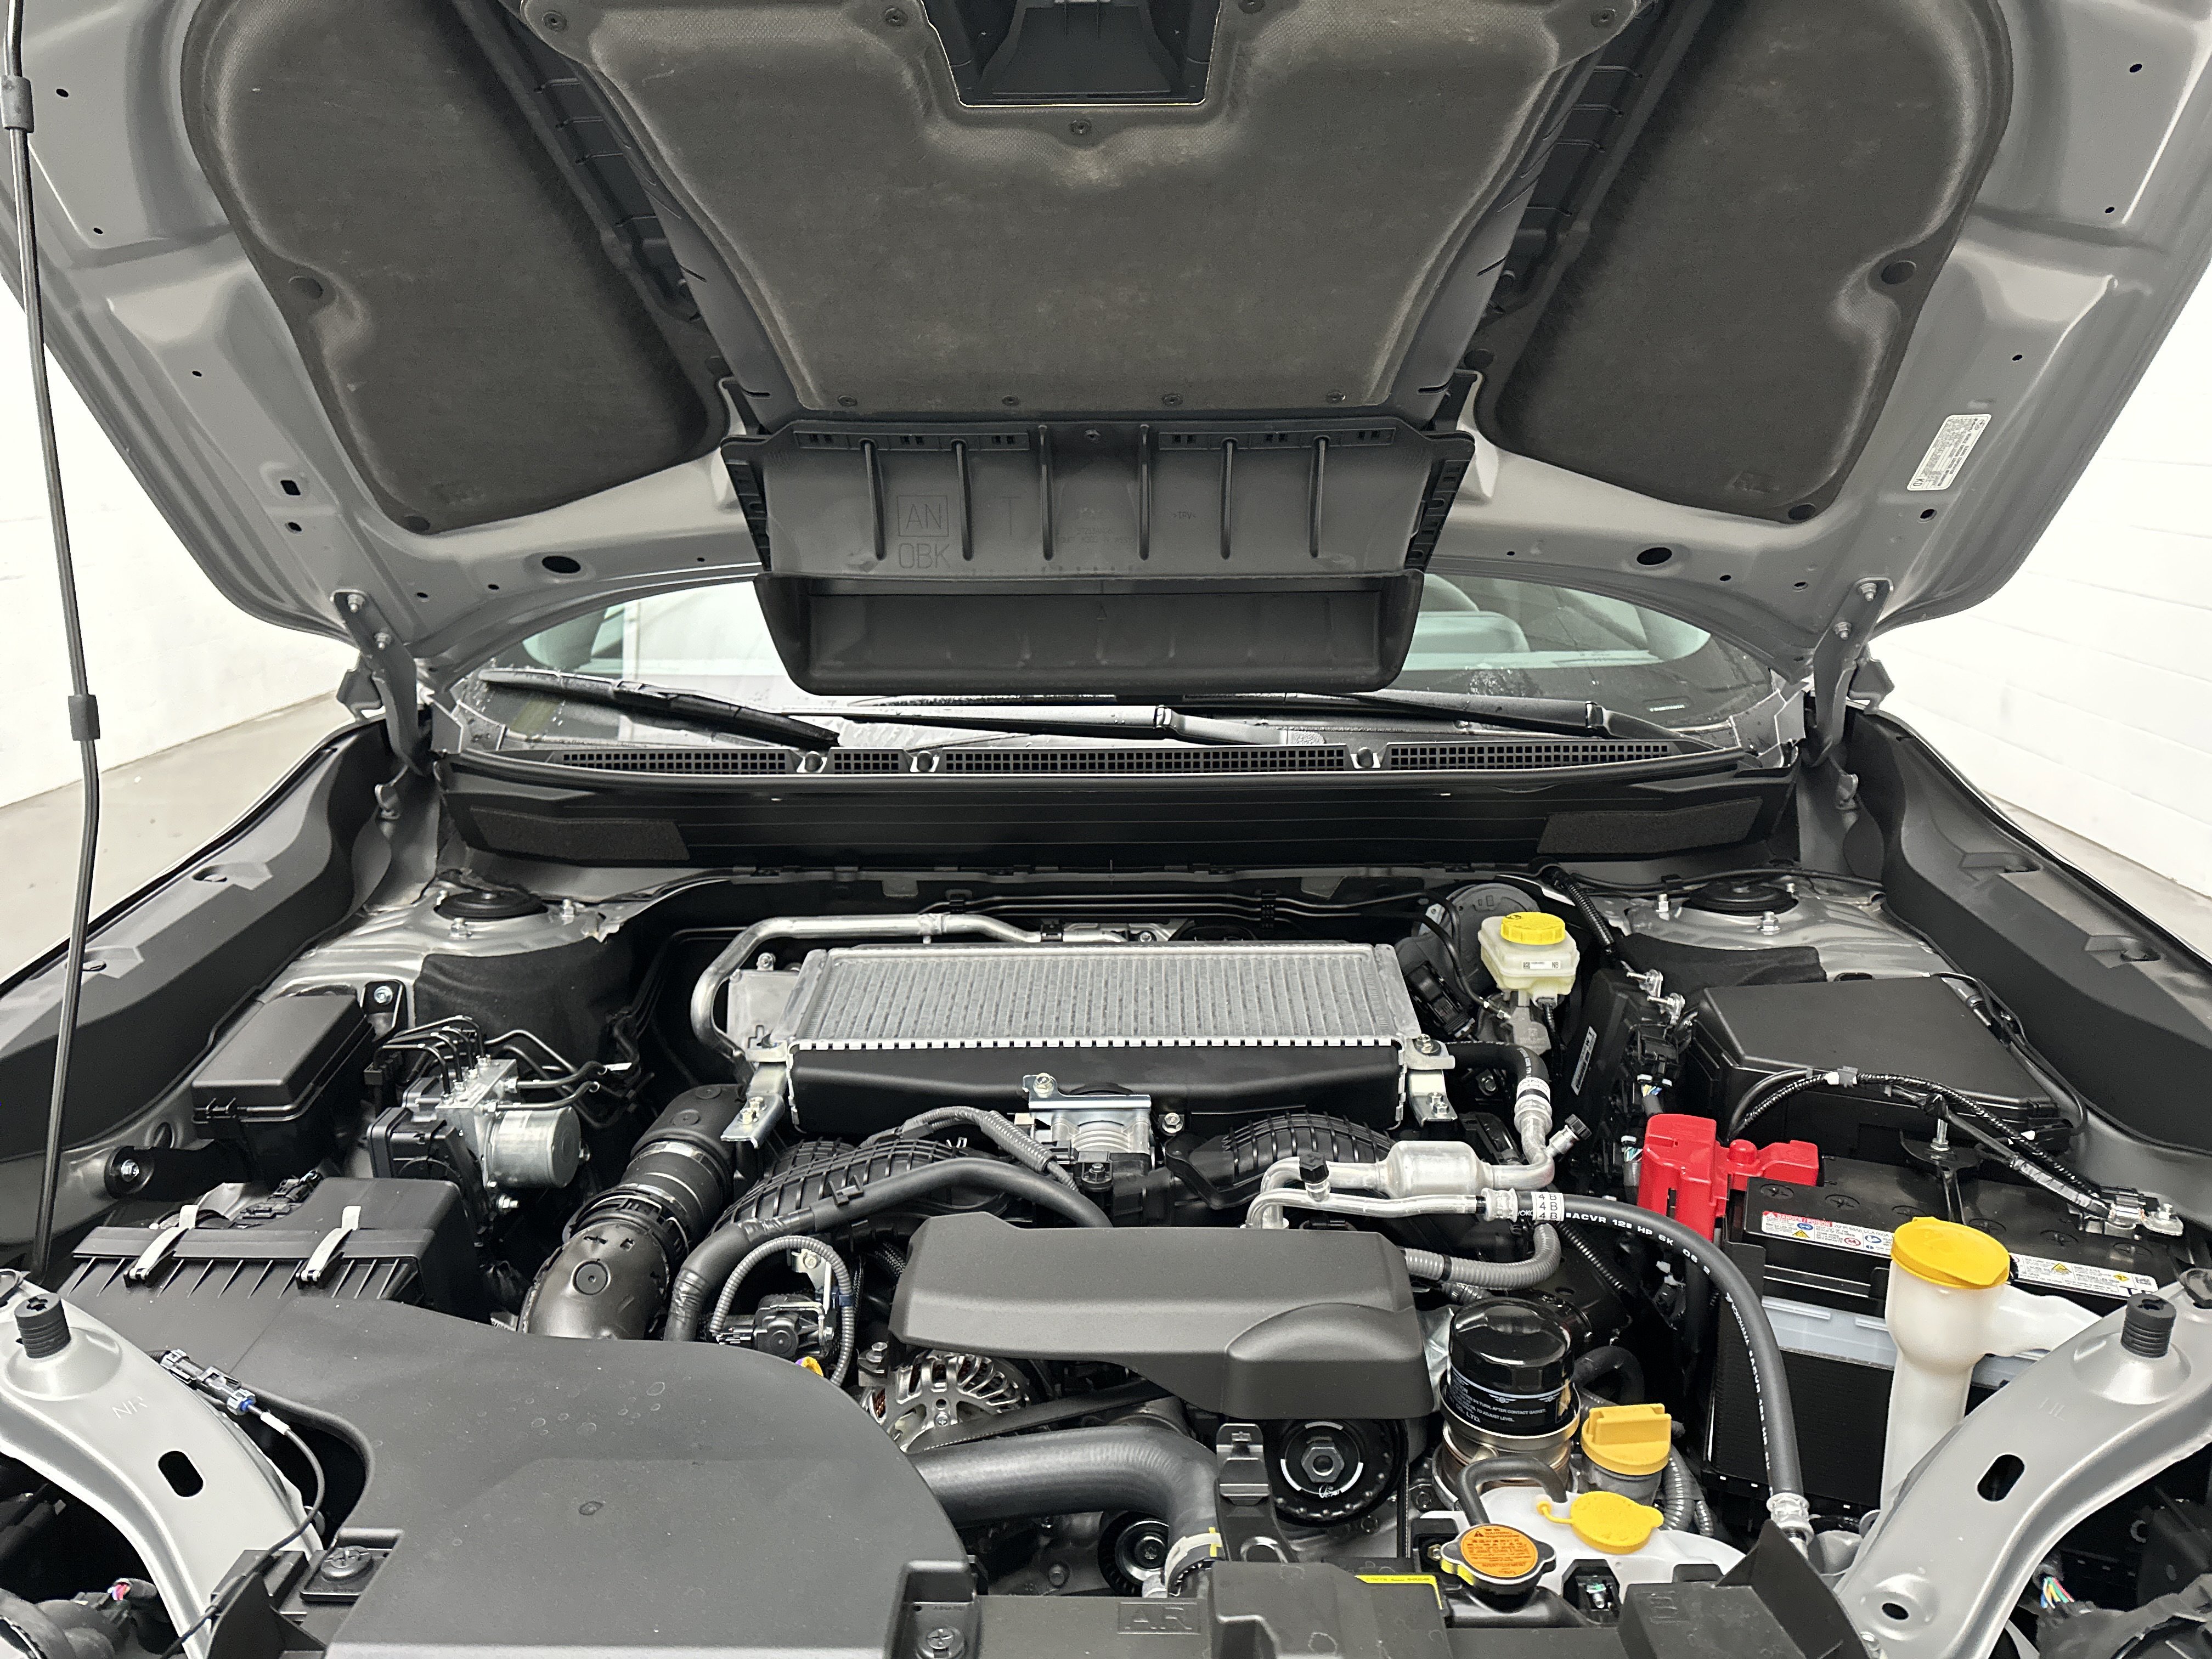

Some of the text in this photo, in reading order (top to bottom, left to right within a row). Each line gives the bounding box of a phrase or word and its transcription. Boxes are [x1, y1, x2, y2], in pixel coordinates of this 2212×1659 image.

[1912, 478, 1924, 487] KD
[905, 503, 943, 530] AN
[898, 543, 951, 569] OBK
[1539, 1202, 1558, 1211] 4 B
[1572, 1212, 1606, 1223] ACVR
[1638, 1226, 1652, 1235] HP
[1658, 1234, 1673, 1246] 6K
[112, 1396, 148, 1419] NR
[1124, 1605, 1193, 1630] AR
